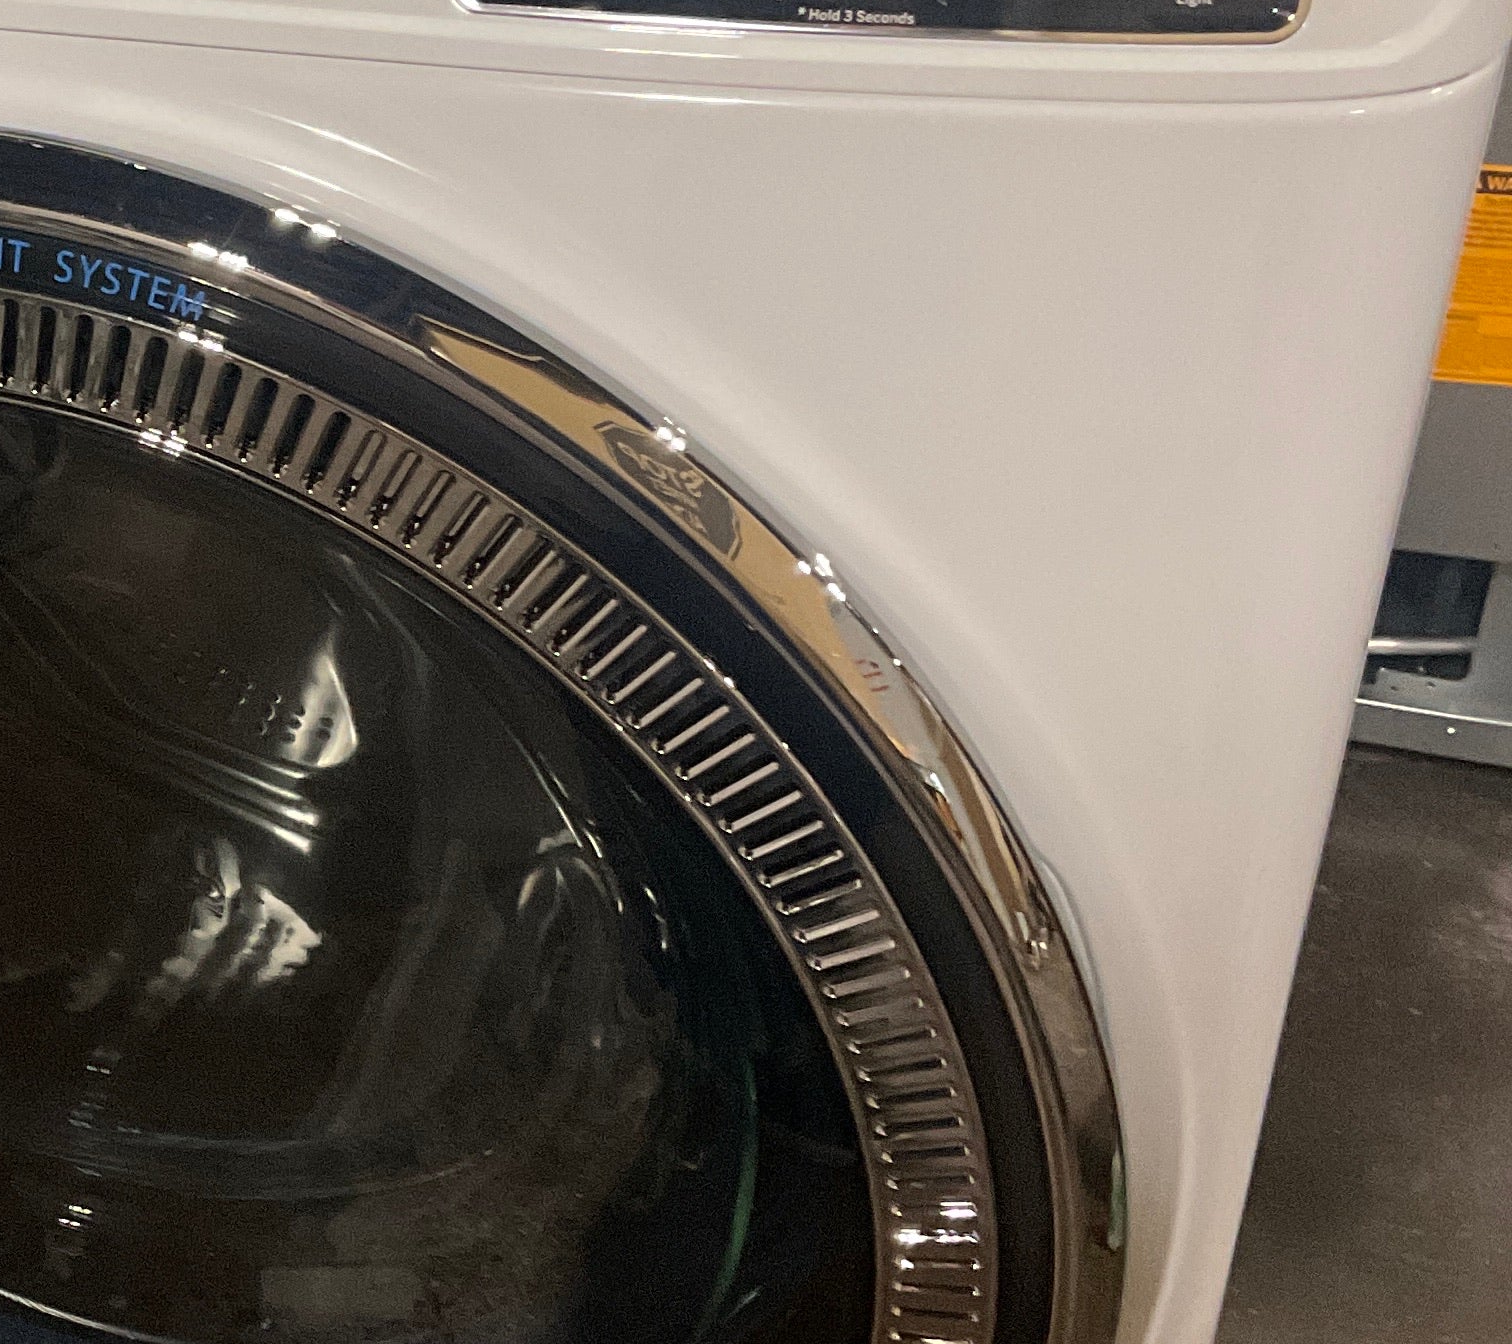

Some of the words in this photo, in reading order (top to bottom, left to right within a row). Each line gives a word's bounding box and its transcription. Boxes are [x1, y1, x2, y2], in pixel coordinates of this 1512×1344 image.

[808, 8, 841, 22] Hold
[844, 9, 853, 22] 3
[856, 9, 915, 26] Seconds
[54, 251, 207, 322] SYSTEM
